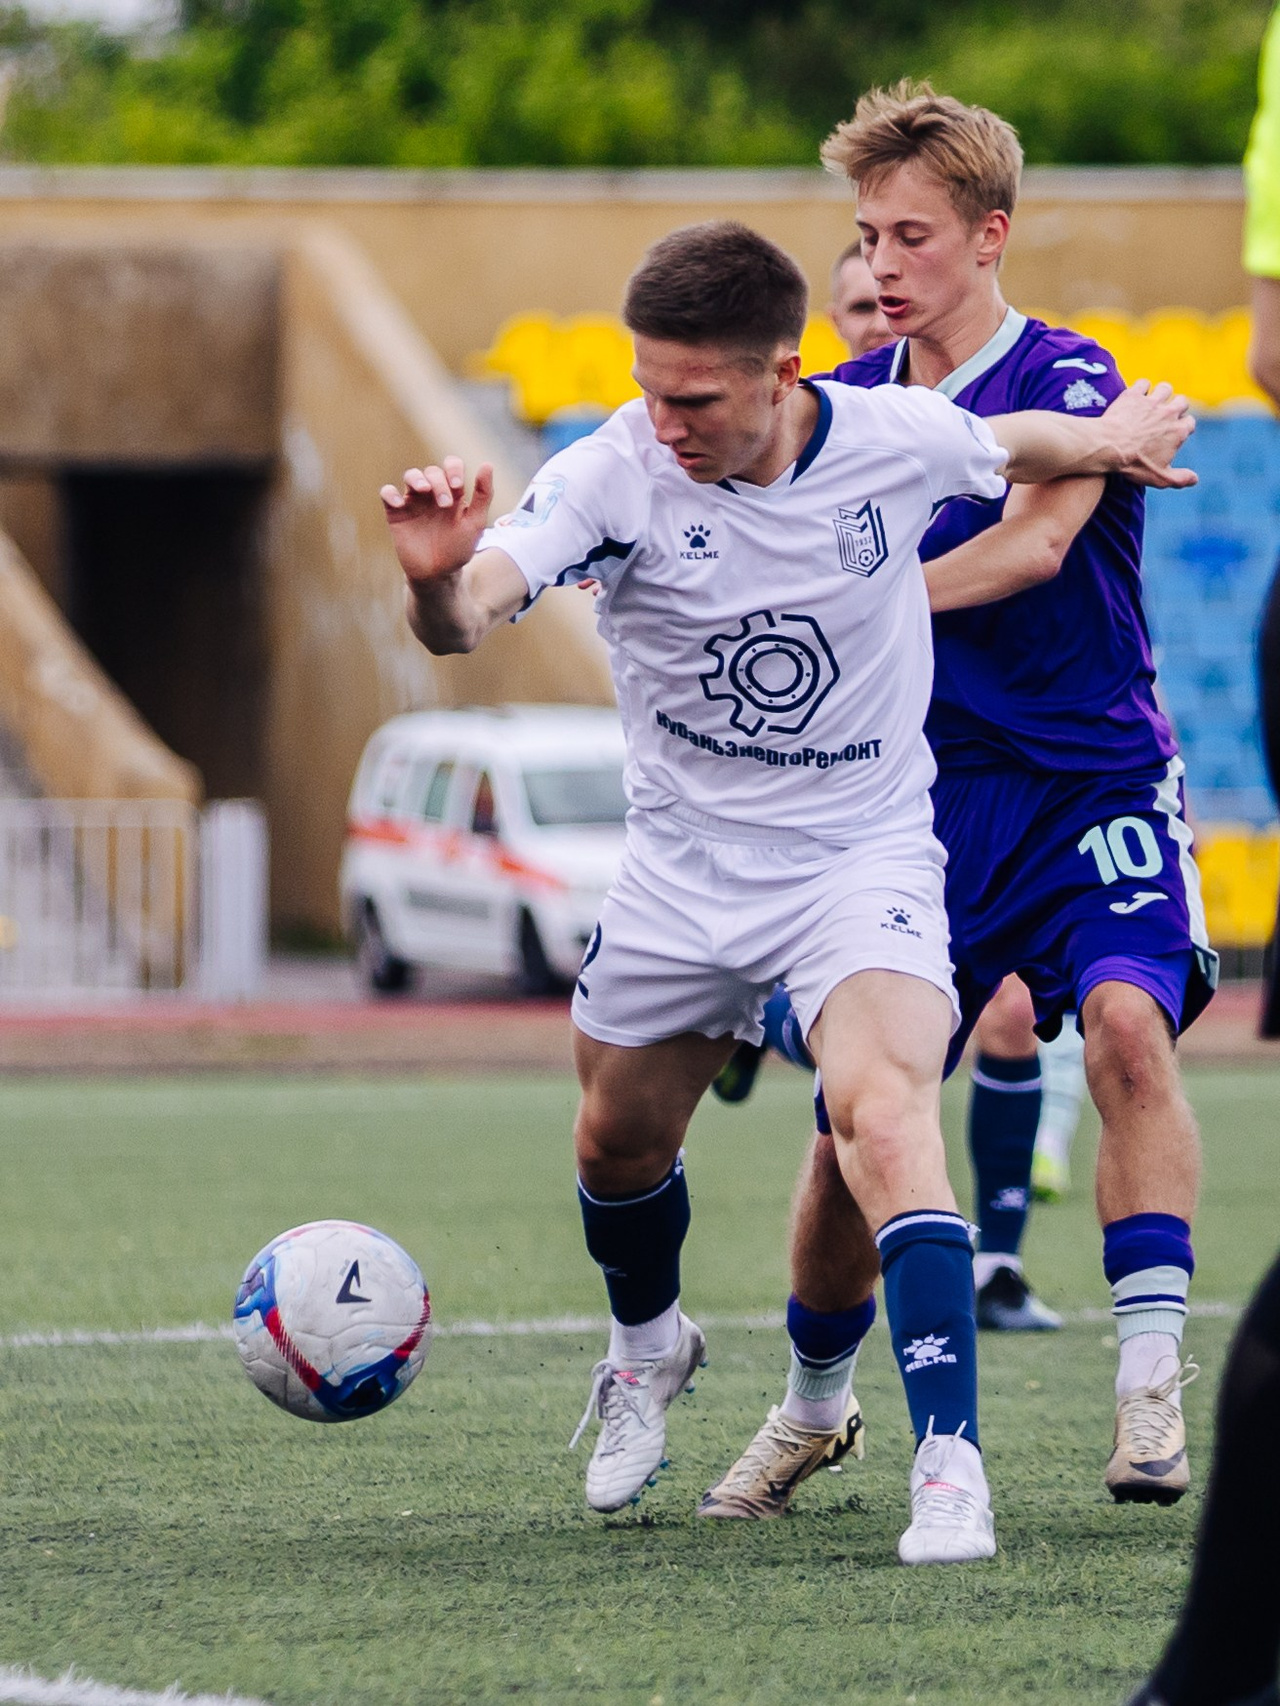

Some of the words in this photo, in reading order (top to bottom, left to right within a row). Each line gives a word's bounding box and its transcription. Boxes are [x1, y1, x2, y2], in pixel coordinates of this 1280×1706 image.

[679, 549, 720, 561] KELME
[1077, 815, 1164, 886] 10
[880, 922, 923, 940] KELME
